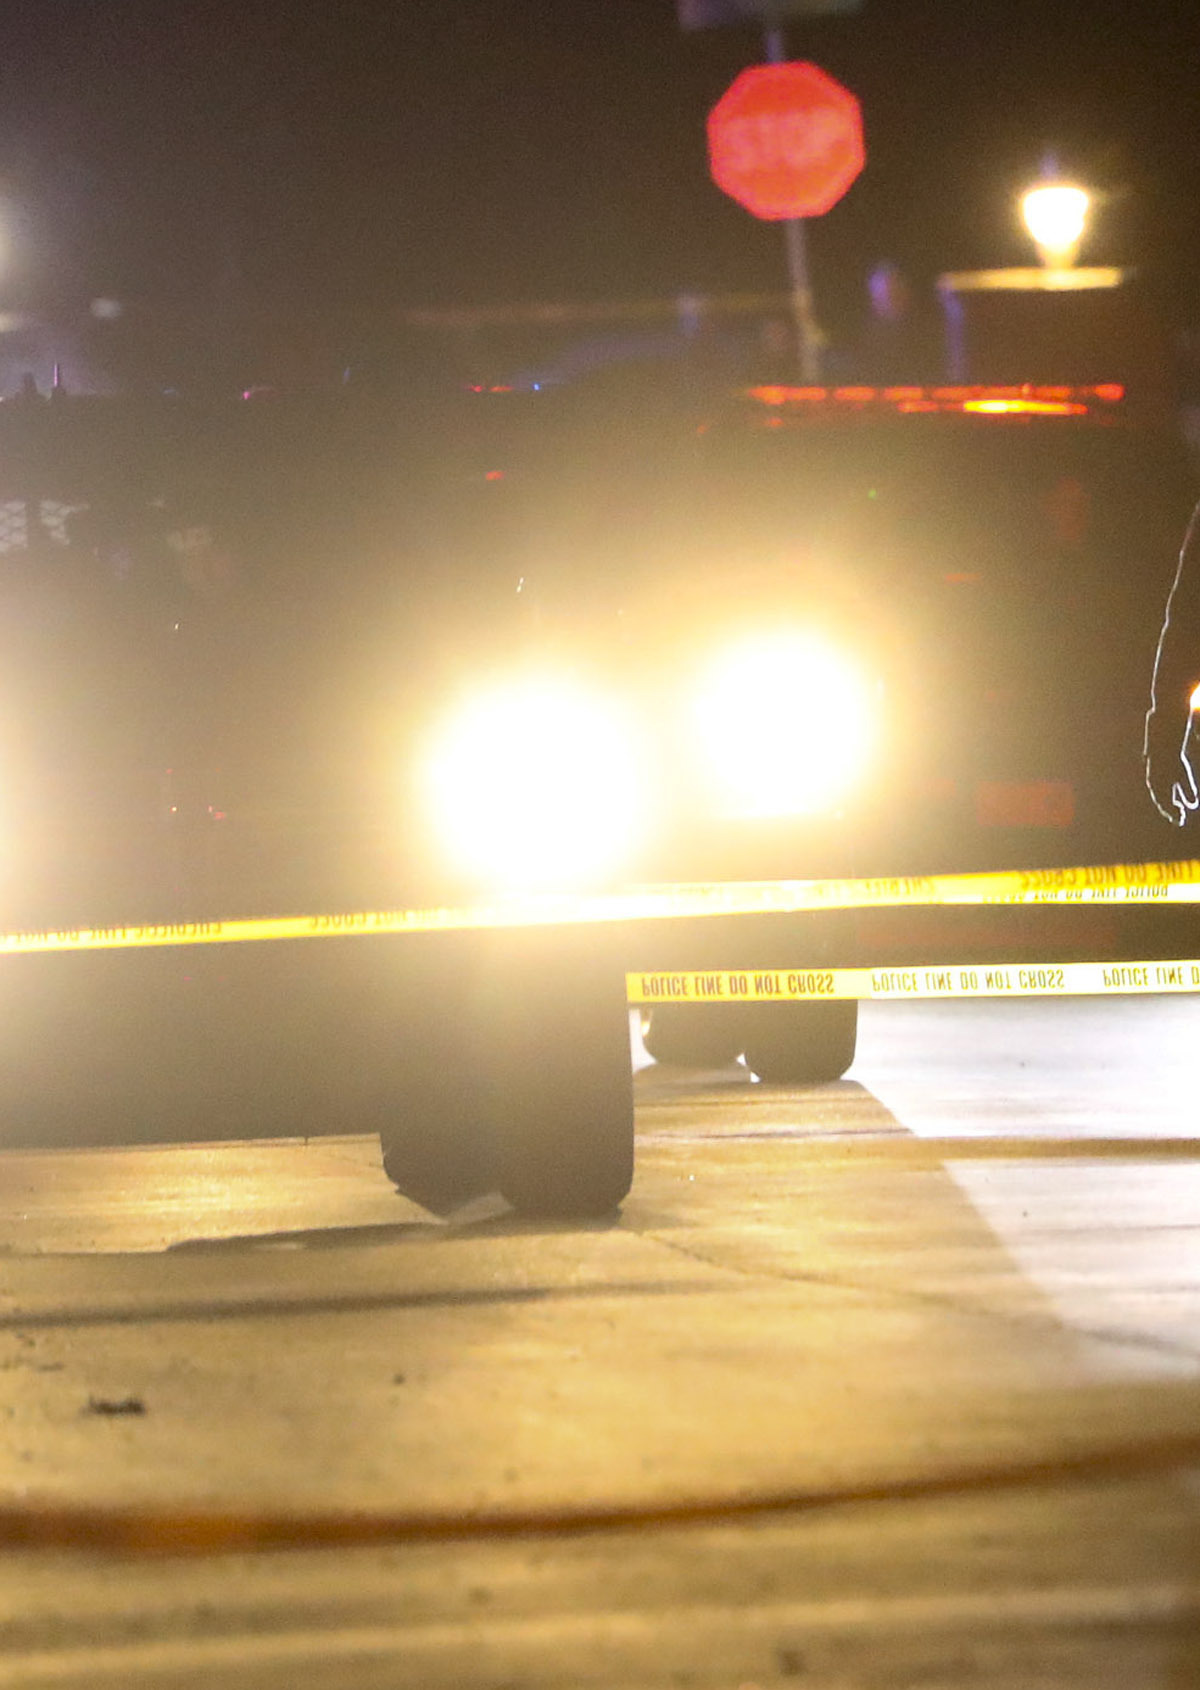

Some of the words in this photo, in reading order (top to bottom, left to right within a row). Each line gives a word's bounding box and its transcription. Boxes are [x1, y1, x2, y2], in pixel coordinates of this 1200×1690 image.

[1021, 869, 1077, 888] CROSS
[1085, 866, 1116, 884] NOT
[1124, 863, 1147, 882] DO
[1153, 861, 1193, 880] LINE
